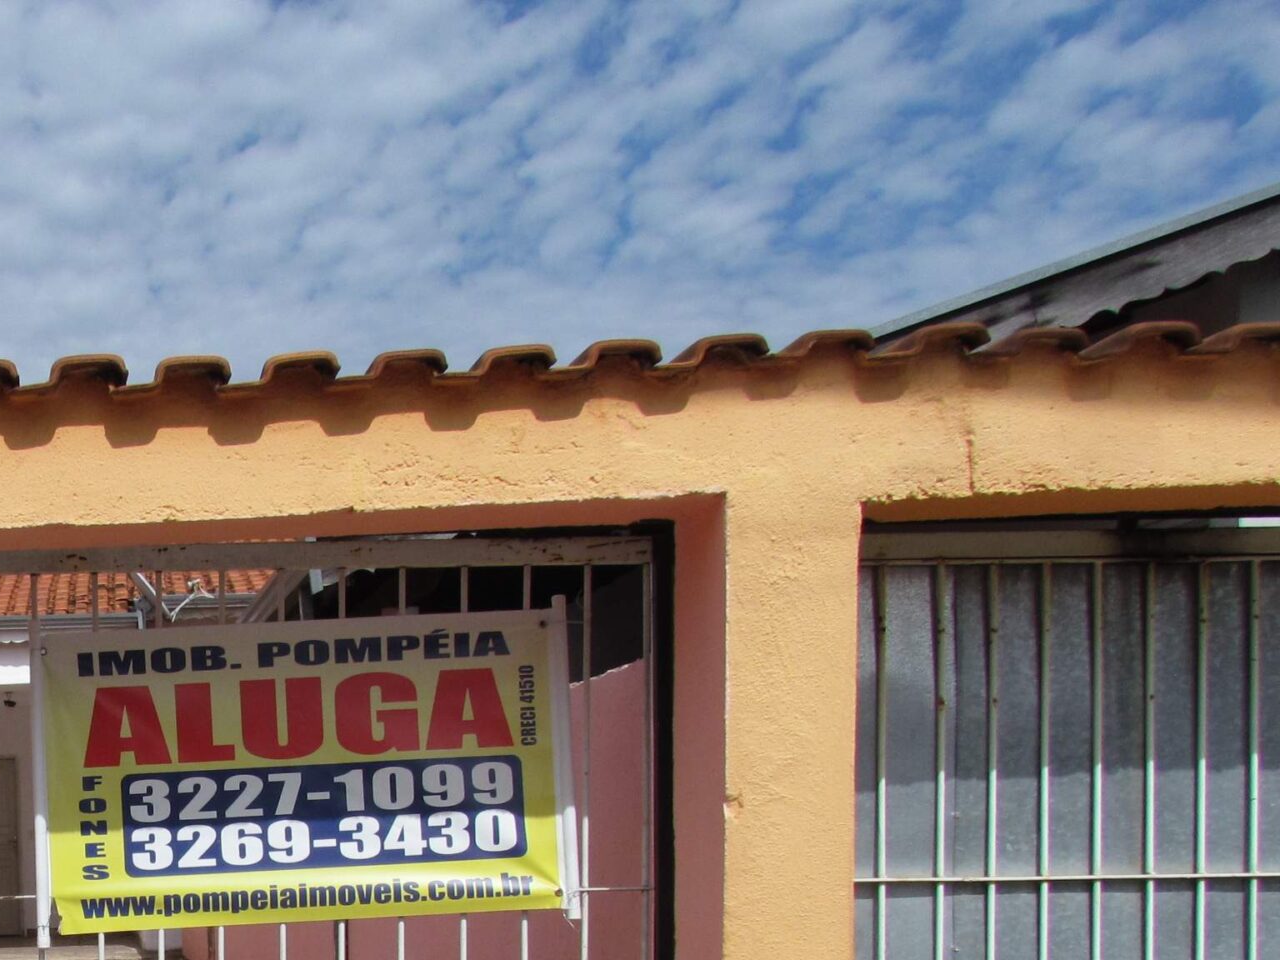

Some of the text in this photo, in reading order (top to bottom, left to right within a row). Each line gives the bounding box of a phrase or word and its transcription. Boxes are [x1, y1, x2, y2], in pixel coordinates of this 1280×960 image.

[77, 629, 510, 677] IMOB. POMPÉIA
[83, 667, 515, 768] ALUGA
[518, 664, 537, 746] CRECI 41510
[128, 760, 514, 823] 3227-1099
[79, 776, 110, 880] FONES
[130, 808, 517, 871] 3269-3430
[81, 872, 535, 919] www.pompeiaimoveis.com.br
